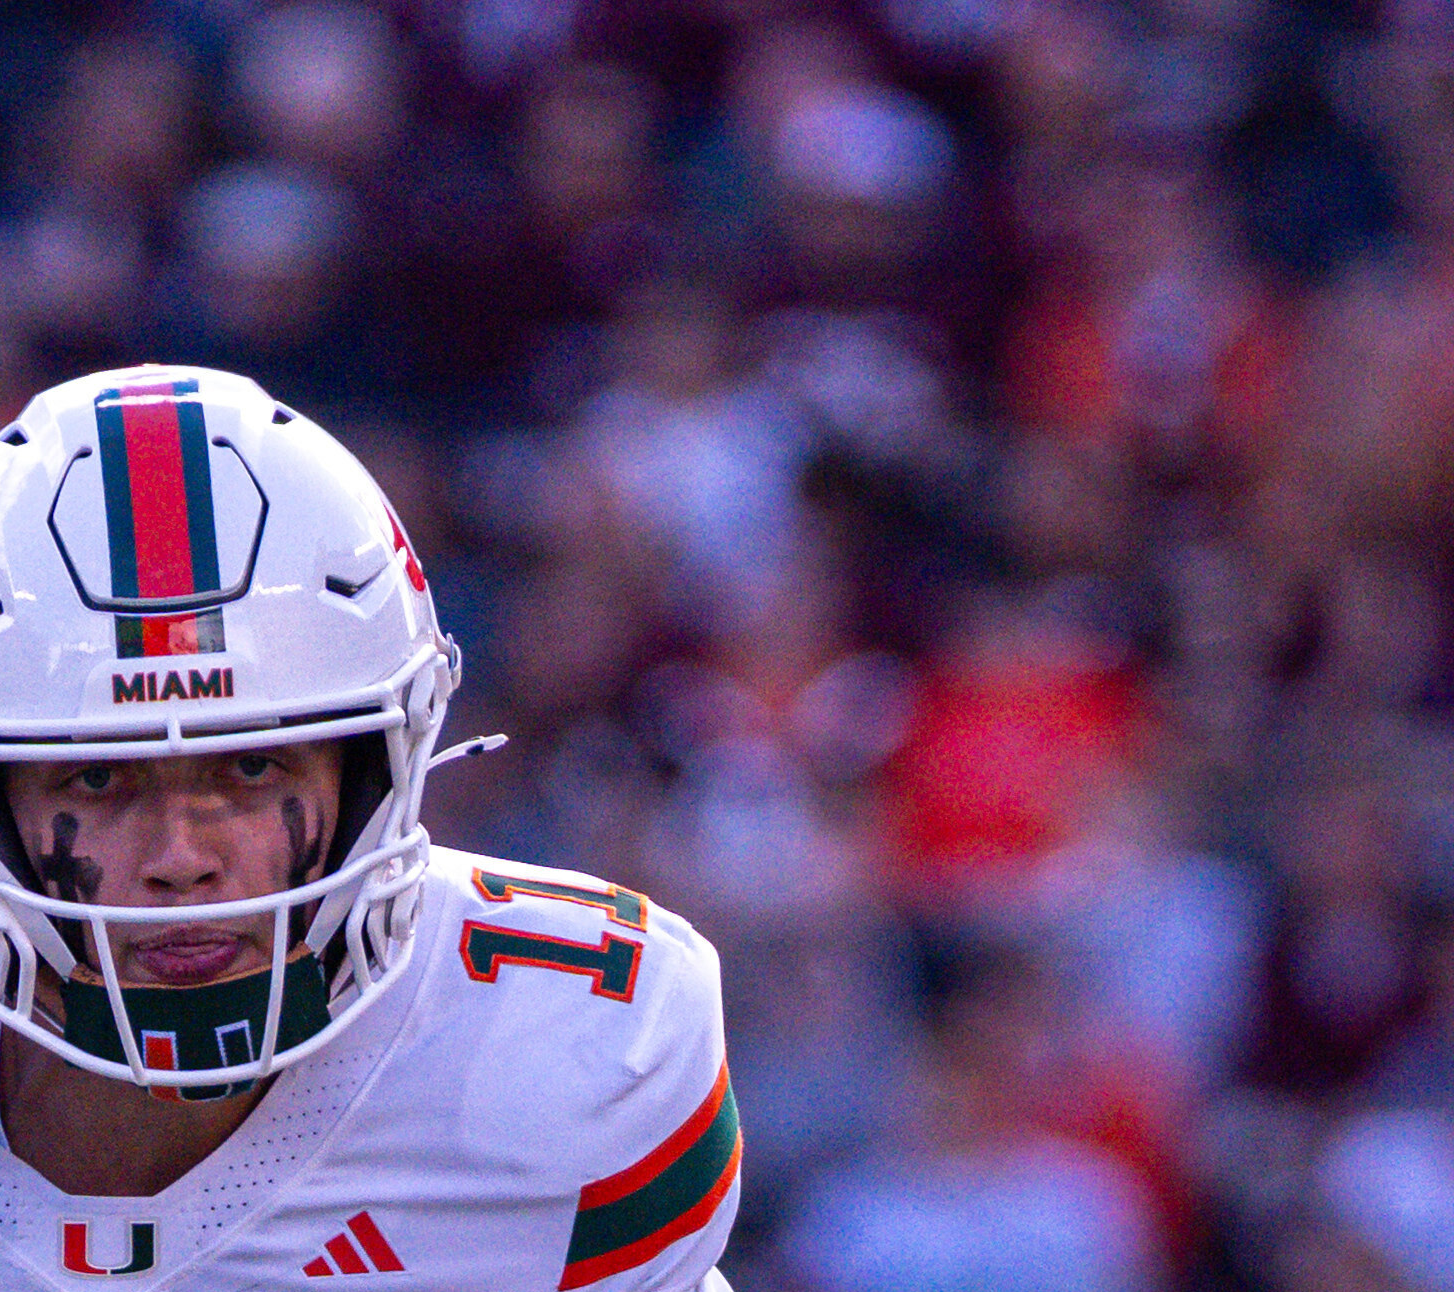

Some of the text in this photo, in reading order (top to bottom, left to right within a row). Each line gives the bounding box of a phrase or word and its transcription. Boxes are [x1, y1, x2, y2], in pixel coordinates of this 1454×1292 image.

[111, 667, 235, 704] MIAMI
[458, 867, 649, 1004] 11
[62, 1222, 155, 1275] U
